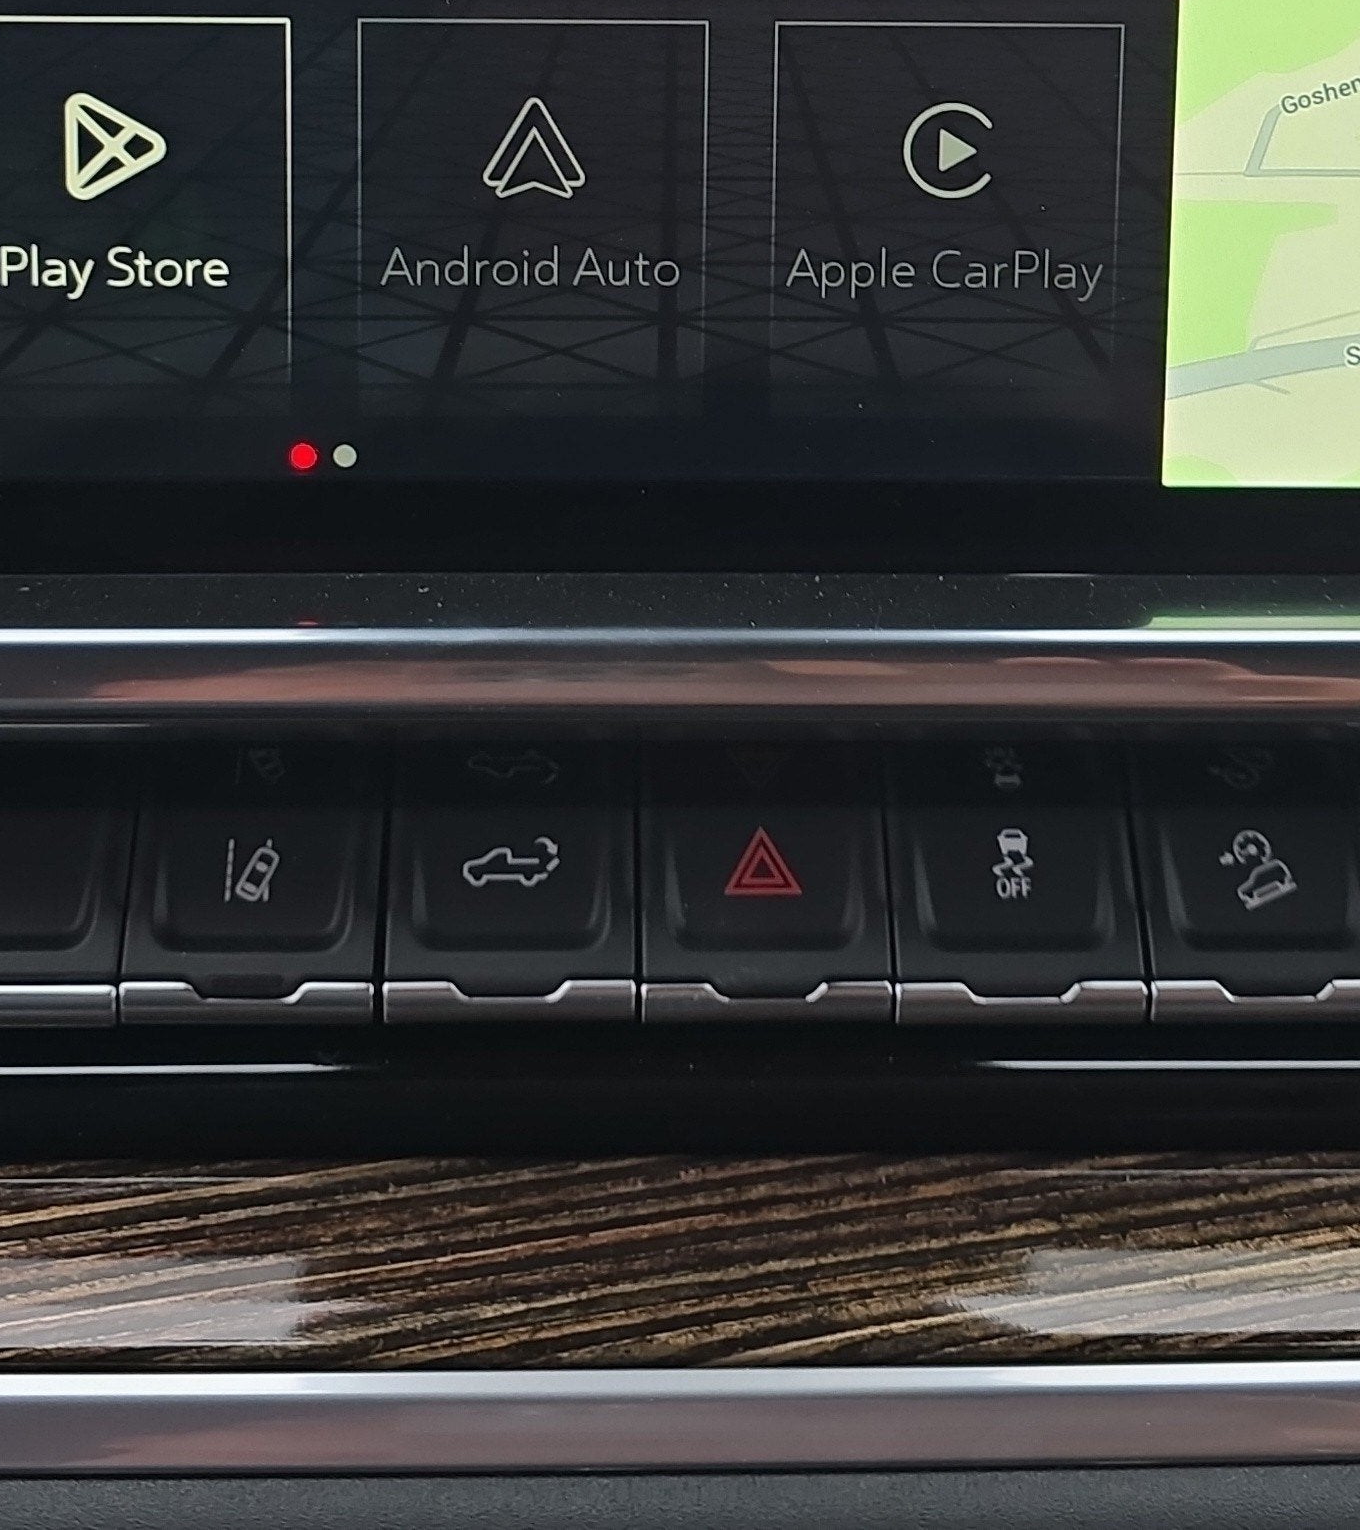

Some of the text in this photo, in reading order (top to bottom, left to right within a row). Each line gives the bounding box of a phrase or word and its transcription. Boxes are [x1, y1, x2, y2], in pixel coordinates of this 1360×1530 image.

[0, 245, 230, 301] Play Store
[380, 245, 681, 289] Android Auto
[786, 248, 1103, 303] Apple CarPlay
[995, 878, 1032, 900] OFF
